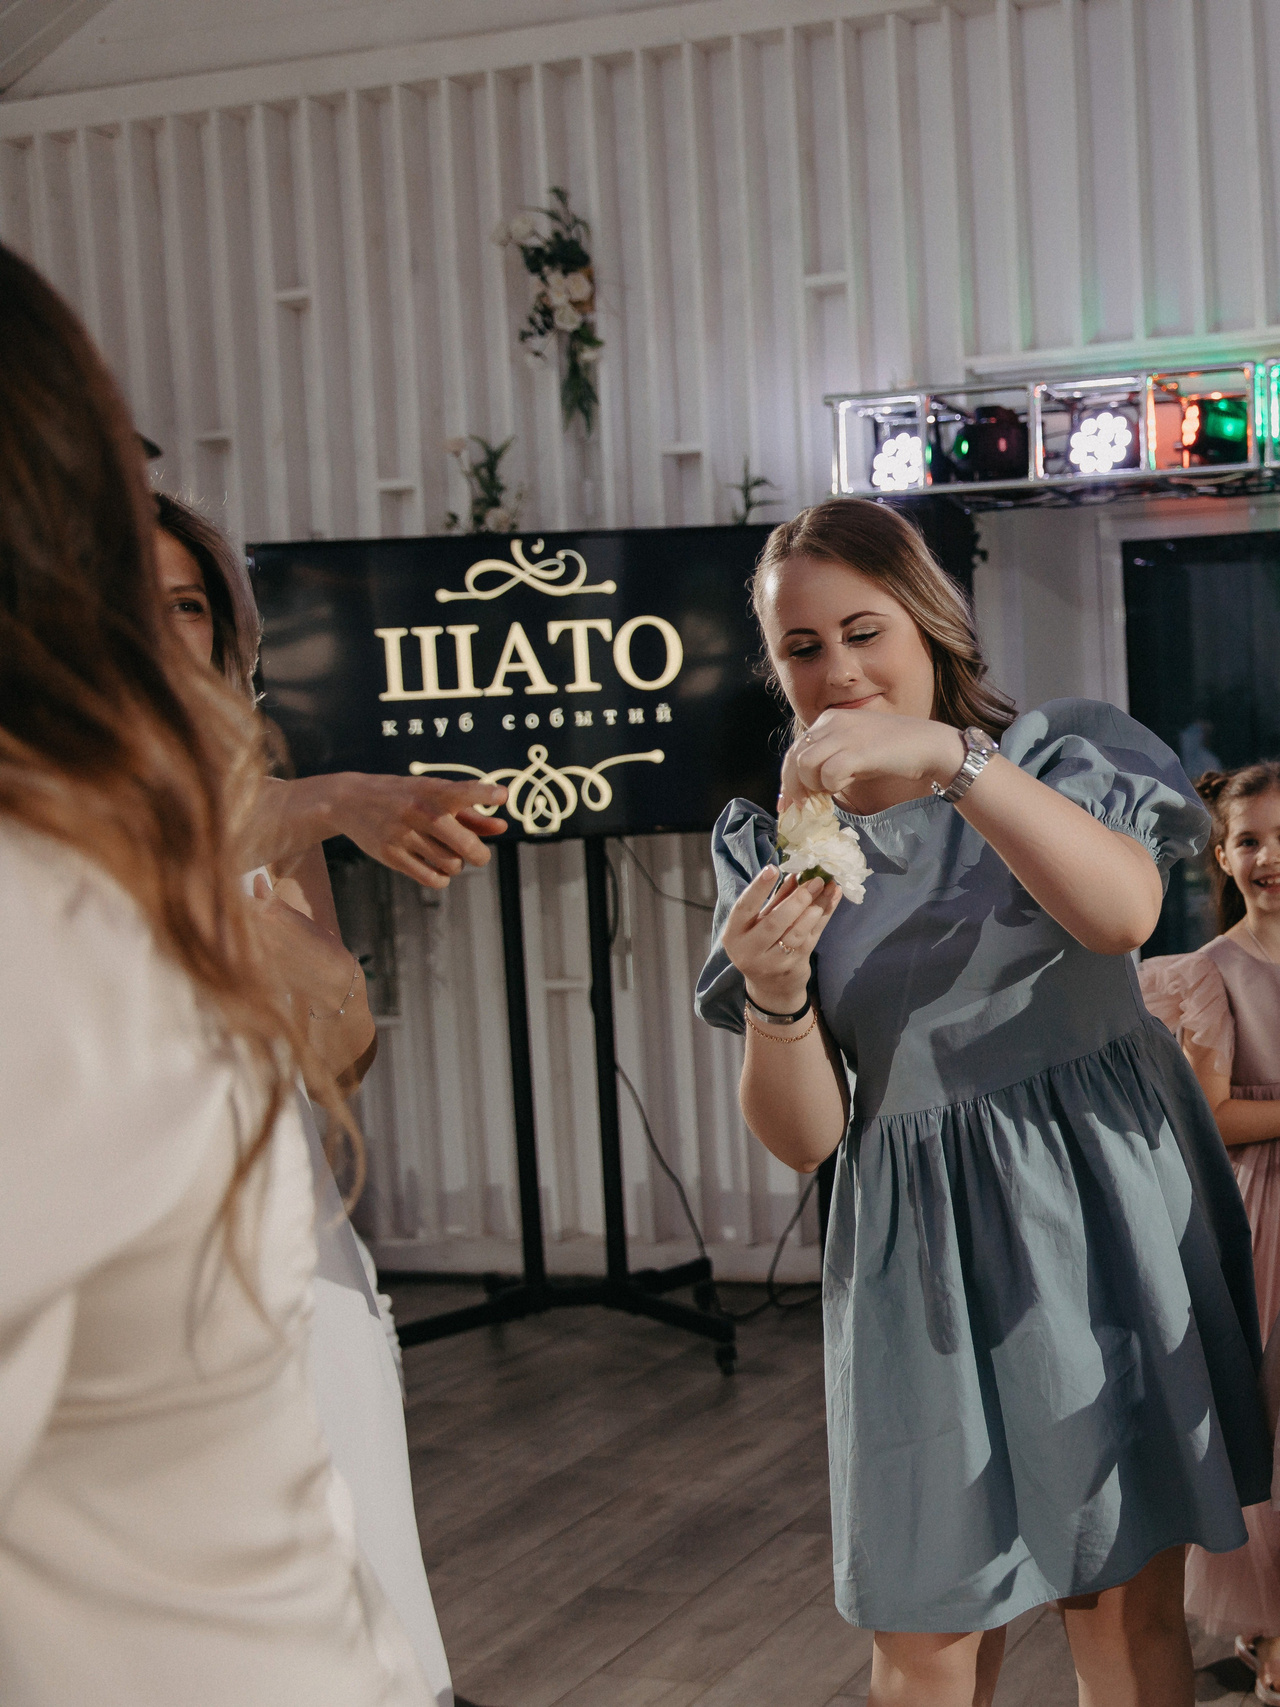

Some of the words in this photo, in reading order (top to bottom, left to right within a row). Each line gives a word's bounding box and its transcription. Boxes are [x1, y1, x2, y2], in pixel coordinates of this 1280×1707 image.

[374, 614, 684, 701] ШАТО
[381, 711, 474, 737] клуб
[501, 702, 673, 731] событий
